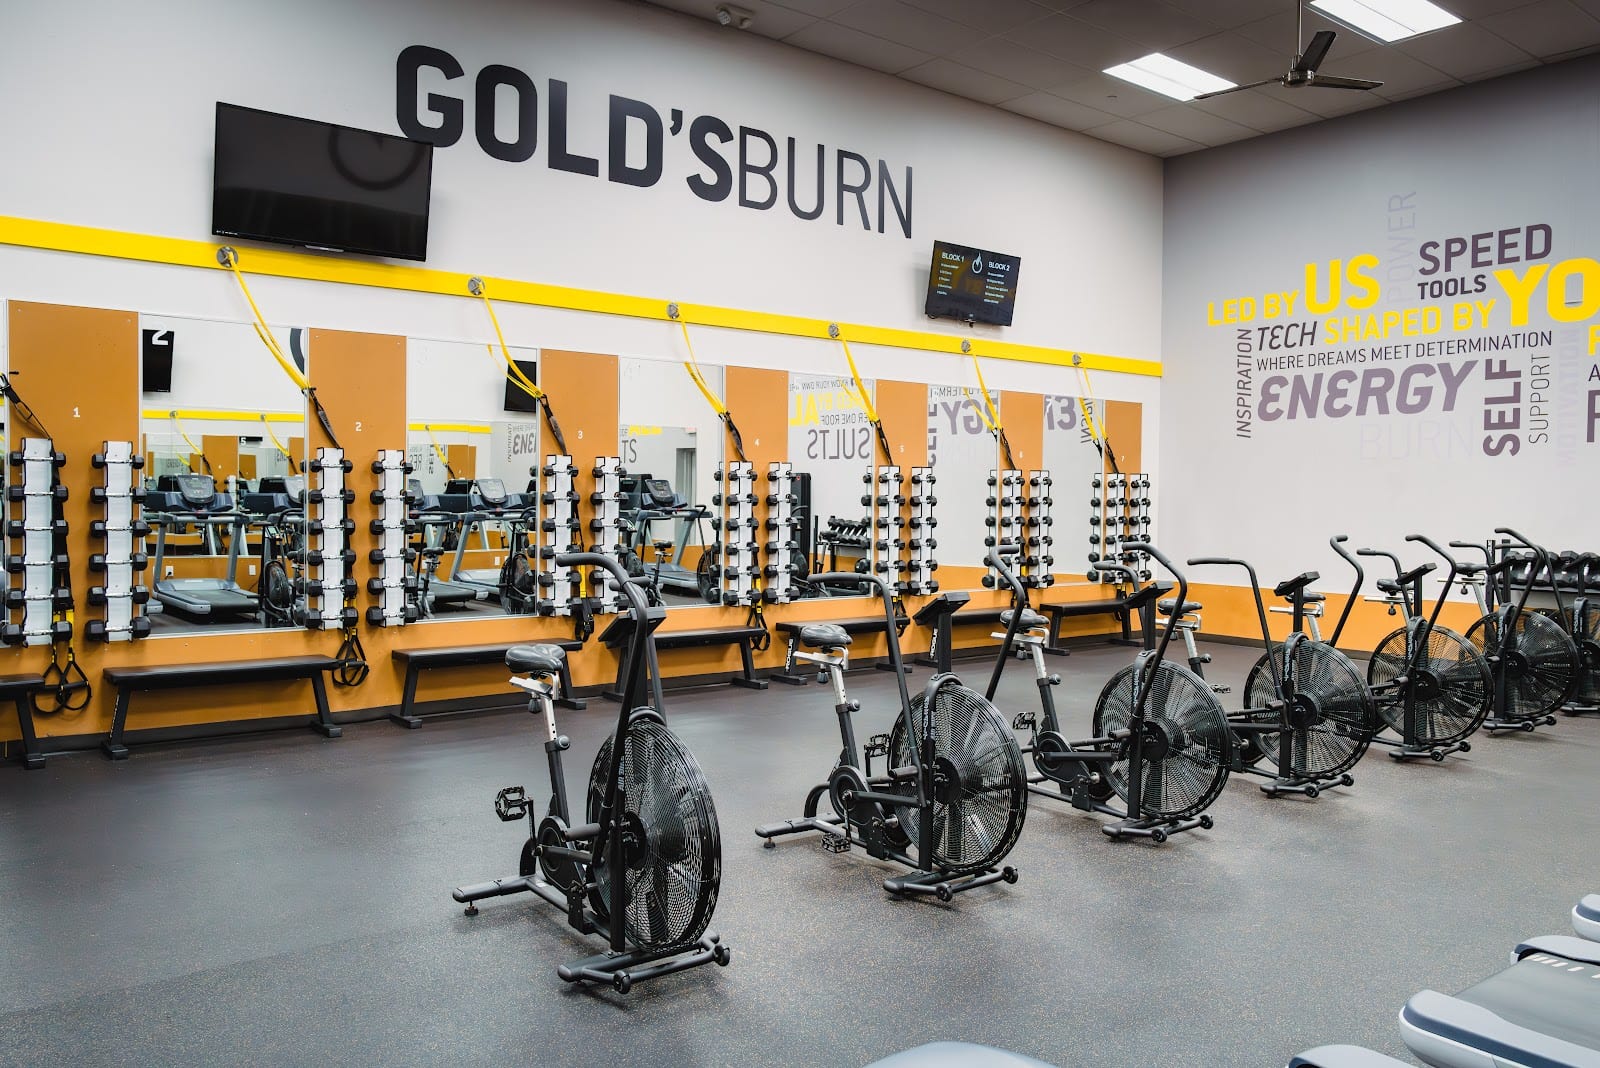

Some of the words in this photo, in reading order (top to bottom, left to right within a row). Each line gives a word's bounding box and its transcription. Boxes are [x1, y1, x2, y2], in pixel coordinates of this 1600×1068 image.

[942, 252, 961, 261] BLOCK
[988, 261, 1006, 270] BLOCK
[1418, 223, 1552, 276] SPEED
[1207, 297, 1256, 326] LED
[1263, 289, 1299, 319] BY
[1304, 254, 1381, 315] US
[1417, 274, 1487, 300] TOOLS
[1323, 305, 1442, 345] SHAPED
[1453, 299, 1497, 333] BY
[1256, 354, 1304, 371] WHERE
[1308, 347, 1367, 368] DREAMS
[1371, 344, 1412, 362] MEET
[1415, 330, 1552, 359] DETERMINATION
[1236, 328, 1252, 439] INSPIRATION
[1257, 359, 1479, 422] ENERGY
[1528, 353, 1550, 444] SUPPORT
[72, 406, 81, 418] 1
[355, 421, 363, 433] 2
[1482, 358, 1522, 457] SELF
[577, 430, 584, 440] 3
[754, 439, 760, 447] 4
